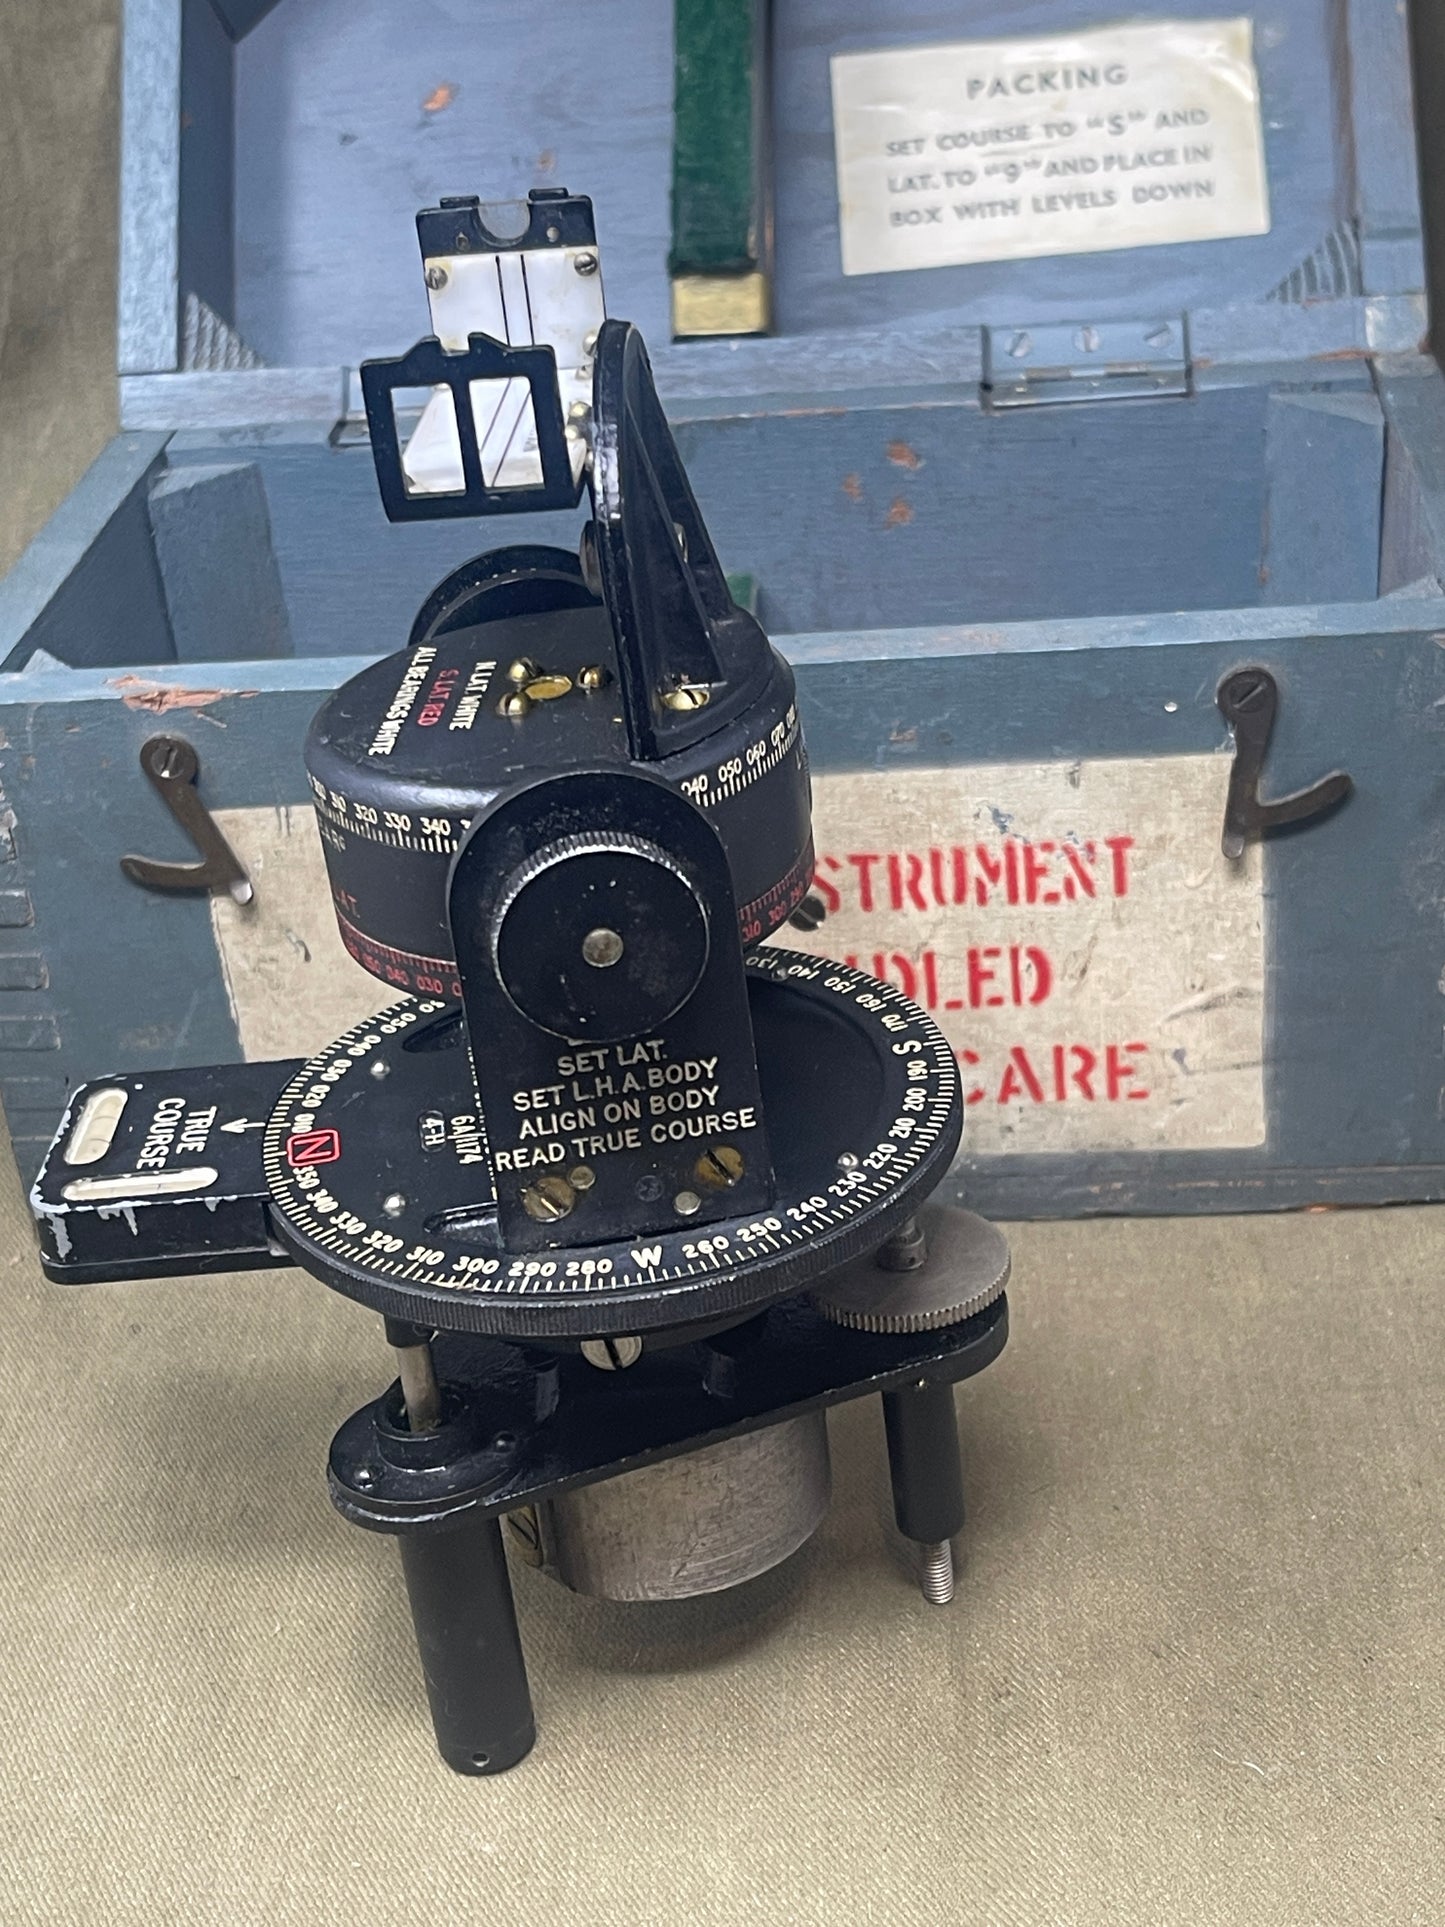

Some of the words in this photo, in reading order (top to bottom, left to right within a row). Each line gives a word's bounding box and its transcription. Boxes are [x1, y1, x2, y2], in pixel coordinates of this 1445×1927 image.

[966, 64, 1129, 99] PACKING
[886, 138, 926, 157] SET
[935, 125, 1032, 152] COURSE
[1043, 121, 1077, 138] TO
[1154, 107, 1210, 130] AND
[942, 170, 977, 189] TO
[1044, 156, 1099, 178] AND
[1102, 147, 1178, 172] PLACE
[1182, 143, 1213, 165] IN
[889, 206, 943, 227] BOX
[953, 199, 1022, 221] WITH
[1031, 189, 1117, 214] LEVELS
[1131, 178, 1215, 204] DOWN
[385, 665, 430, 720] BEARINGS
[416, 702, 446, 727] RED
[448, 694, 483, 731] WHITE
[368, 718, 405, 756] WHITE
[718, 758, 741, 782] 050
[746, 741, 766, 765] 060
[771, 721, 785, 747] 070
[354, 802, 378, 825] 320
[383, 811, 411, 832] 330
[420, 816, 451, 836] 340
[741, 920, 762, 943] 310
[416, 974, 443, 994] 030
[788, 965, 820, 980] 140
[824, 976, 857, 994] 150
[845, 945, 1052, 1009] DLED
[855, 993, 887, 1012] 160
[380, 1013, 417, 1034] 050
[881, 1014, 909, 1033] 170
[347, 1034, 382, 1057] 040
[557, 1048, 609, 1076] SET
[616, 1039, 668, 1066] LAT.
[892, 1040, 923, 1056] S
[320, 1059, 353, 1082] 030
[906, 1060, 929, 1082] 190
[301, 1084, 331, 1108] 020
[513, 1085, 566, 1112] SET
[647, 1056, 719, 1087] BODY
[902, 1087, 928, 1112] 200
[291, 1113, 316, 1134] 010
[519, 1106, 596, 1140] ALIGN
[604, 1099, 641, 1124] ON
[649, 1085, 720, 1116] BODY
[136, 1097, 186, 1170] COURSE
[176, 1105, 217, 1154] TRUE
[495, 1142, 566, 1172] READ
[571, 1127, 643, 1158] TRUE
[650, 1107, 757, 1143] COURSE
[888, 1117, 917, 1139] 210
[293, 1135, 333, 1161] N
[863, 1143, 898, 1170] 220
[292, 1165, 321, 1190] 350
[828, 1171, 867, 1197] 230
[305, 1188, 339, 1214] 340
[787, 1196, 828, 1221] 240
[329, 1211, 367, 1235] 330
[736, 1217, 782, 1242] 250
[362, 1230, 404, 1253] 320
[682, 1235, 730, 1258] 260
[405, 1246, 446, 1266] 310
[452, 1256, 500, 1275] 300
[565, 1258, 613, 1274] 280
[630, 1245, 662, 1268] W
[508, 1261, 557, 1277] 290
